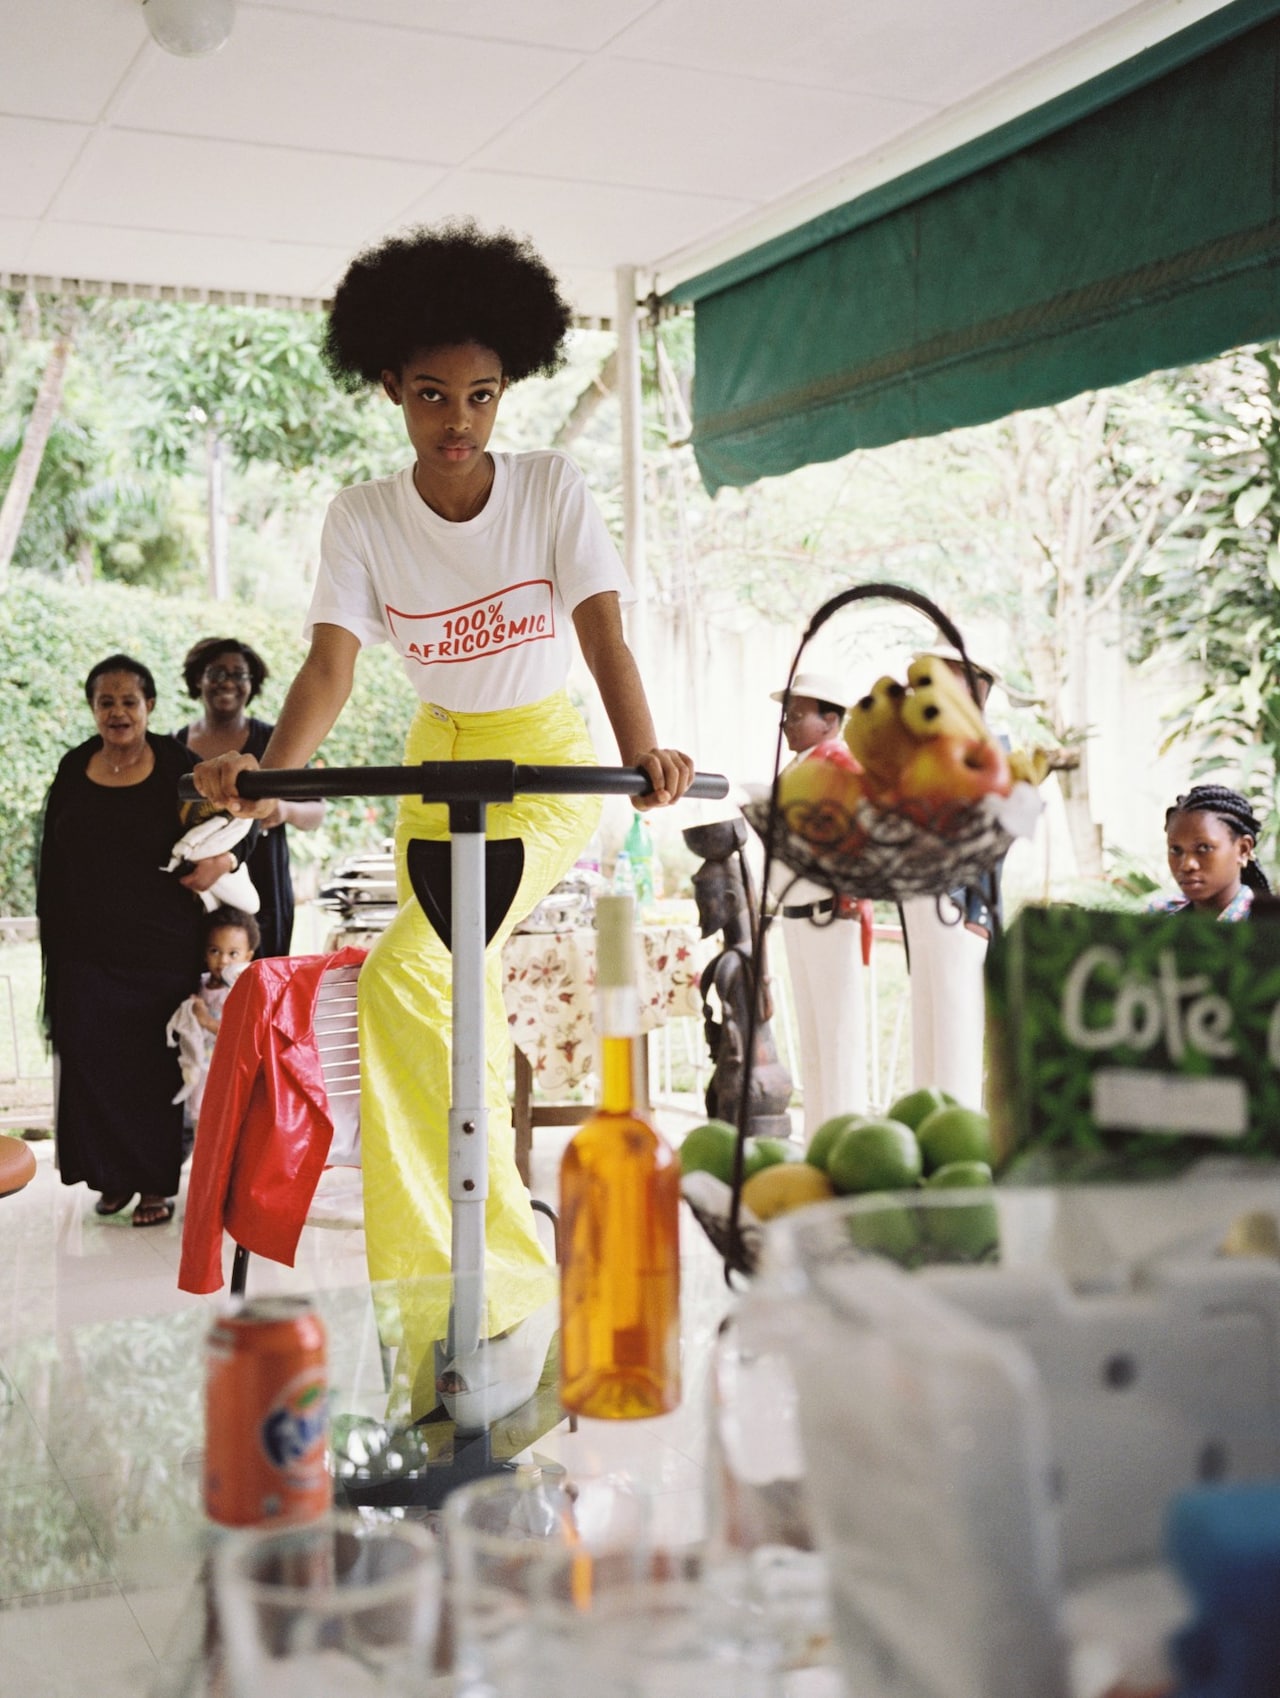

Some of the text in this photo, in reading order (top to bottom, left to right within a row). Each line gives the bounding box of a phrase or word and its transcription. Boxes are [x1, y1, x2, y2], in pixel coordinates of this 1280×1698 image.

[410, 615, 545, 657] AFRICOSMIC
[443, 601, 503, 638] 100%
[1062, 945, 1236, 1060] Cote
